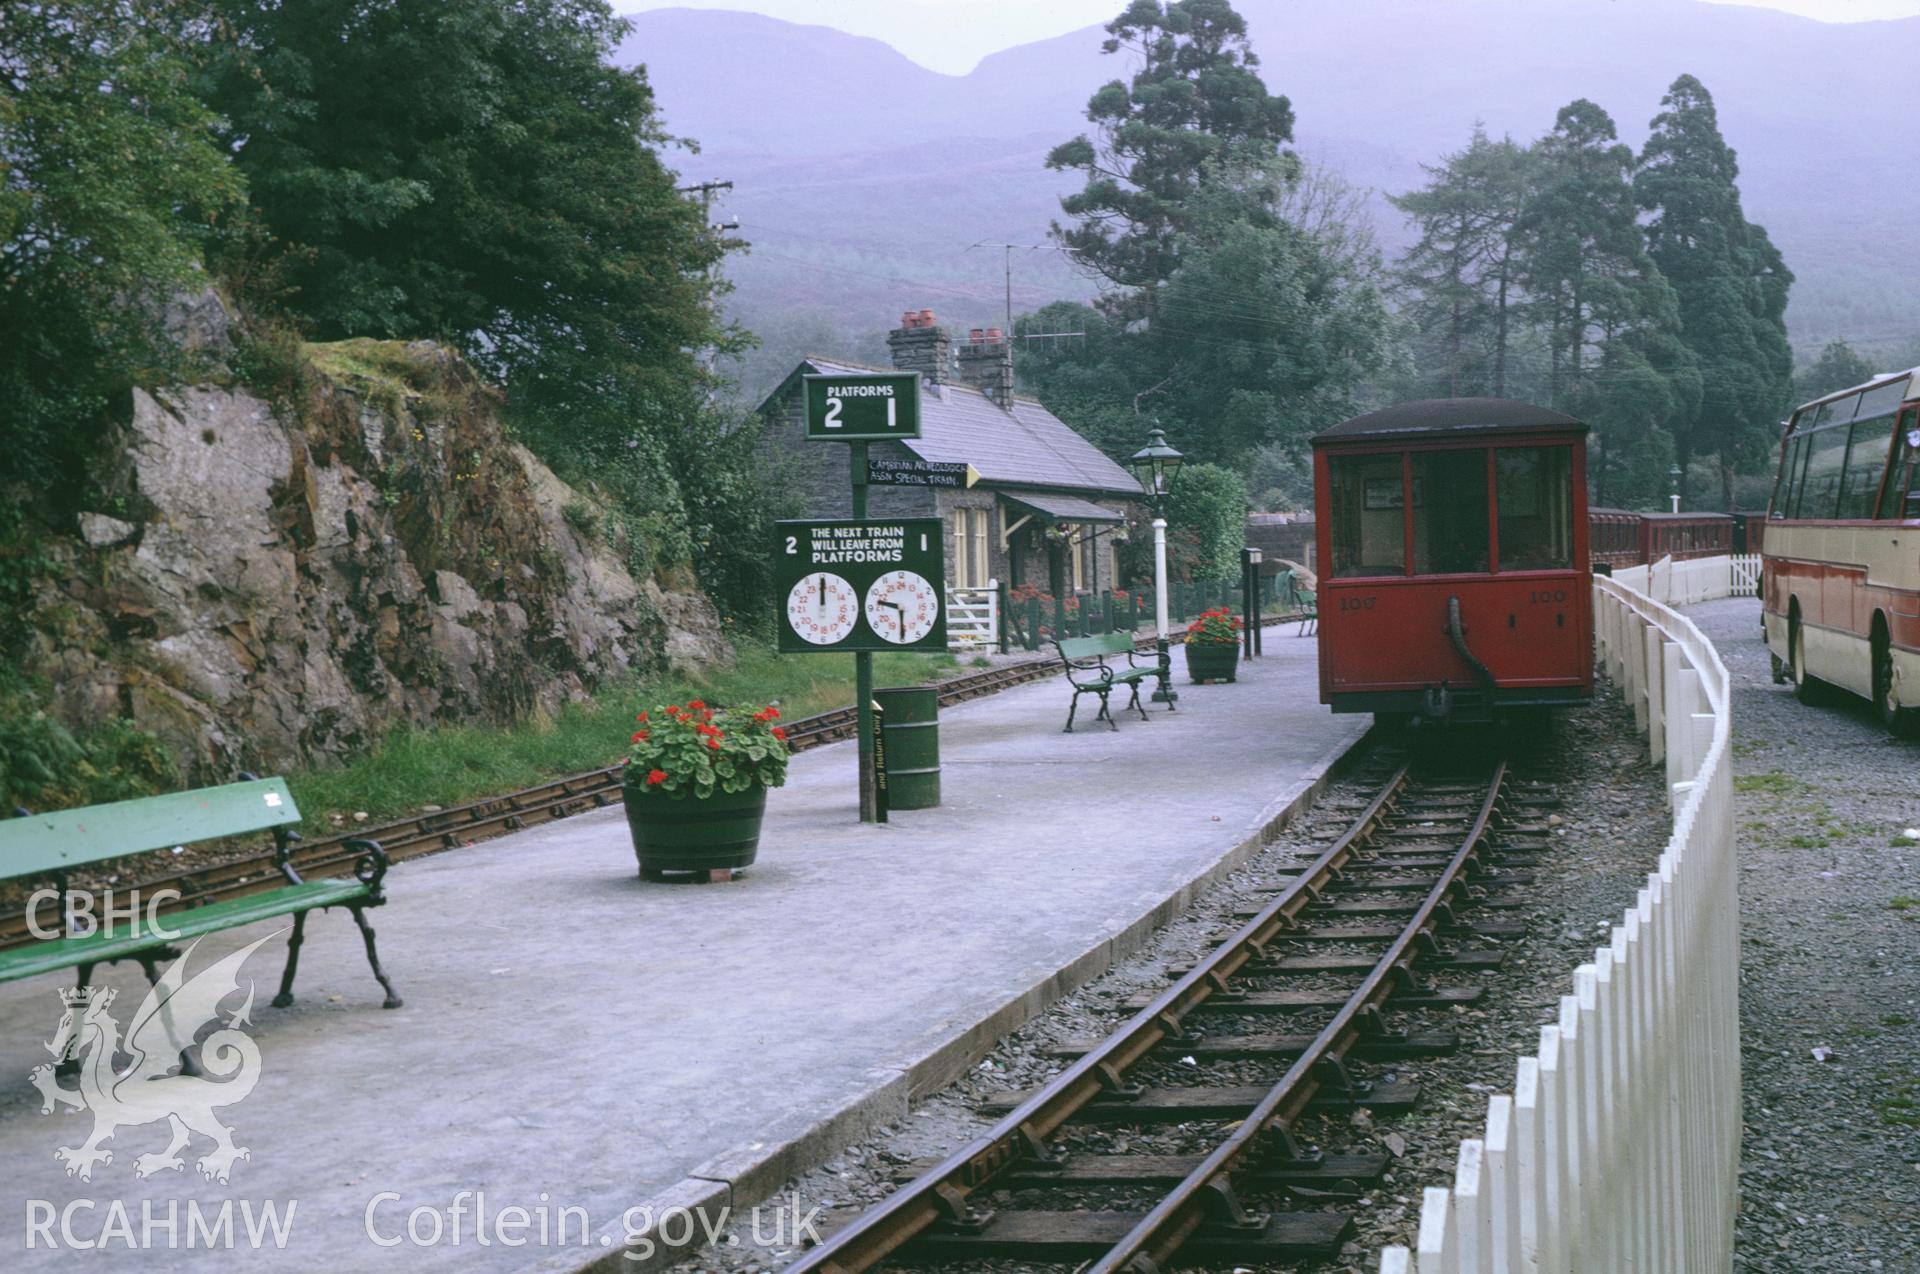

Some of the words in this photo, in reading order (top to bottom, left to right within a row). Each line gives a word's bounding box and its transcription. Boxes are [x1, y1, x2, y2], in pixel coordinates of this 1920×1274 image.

[828, 386, 894, 397] PLATFORMS
[825, 398, 842, 427] 2
[888, 398, 896, 426] 1
[811, 528, 830, 538] THE
[834, 527, 862, 538] NEXT
[867, 527, 904, 537] TRAIN
[786, 536, 797, 554] 2
[811, 540, 838, 550] WILL
[840, 540, 871, 550] LEAVE
[873, 538, 904, 549] FROM
[921, 534, 927, 551] 1
[812, 550, 903, 563] PLATFORMS
